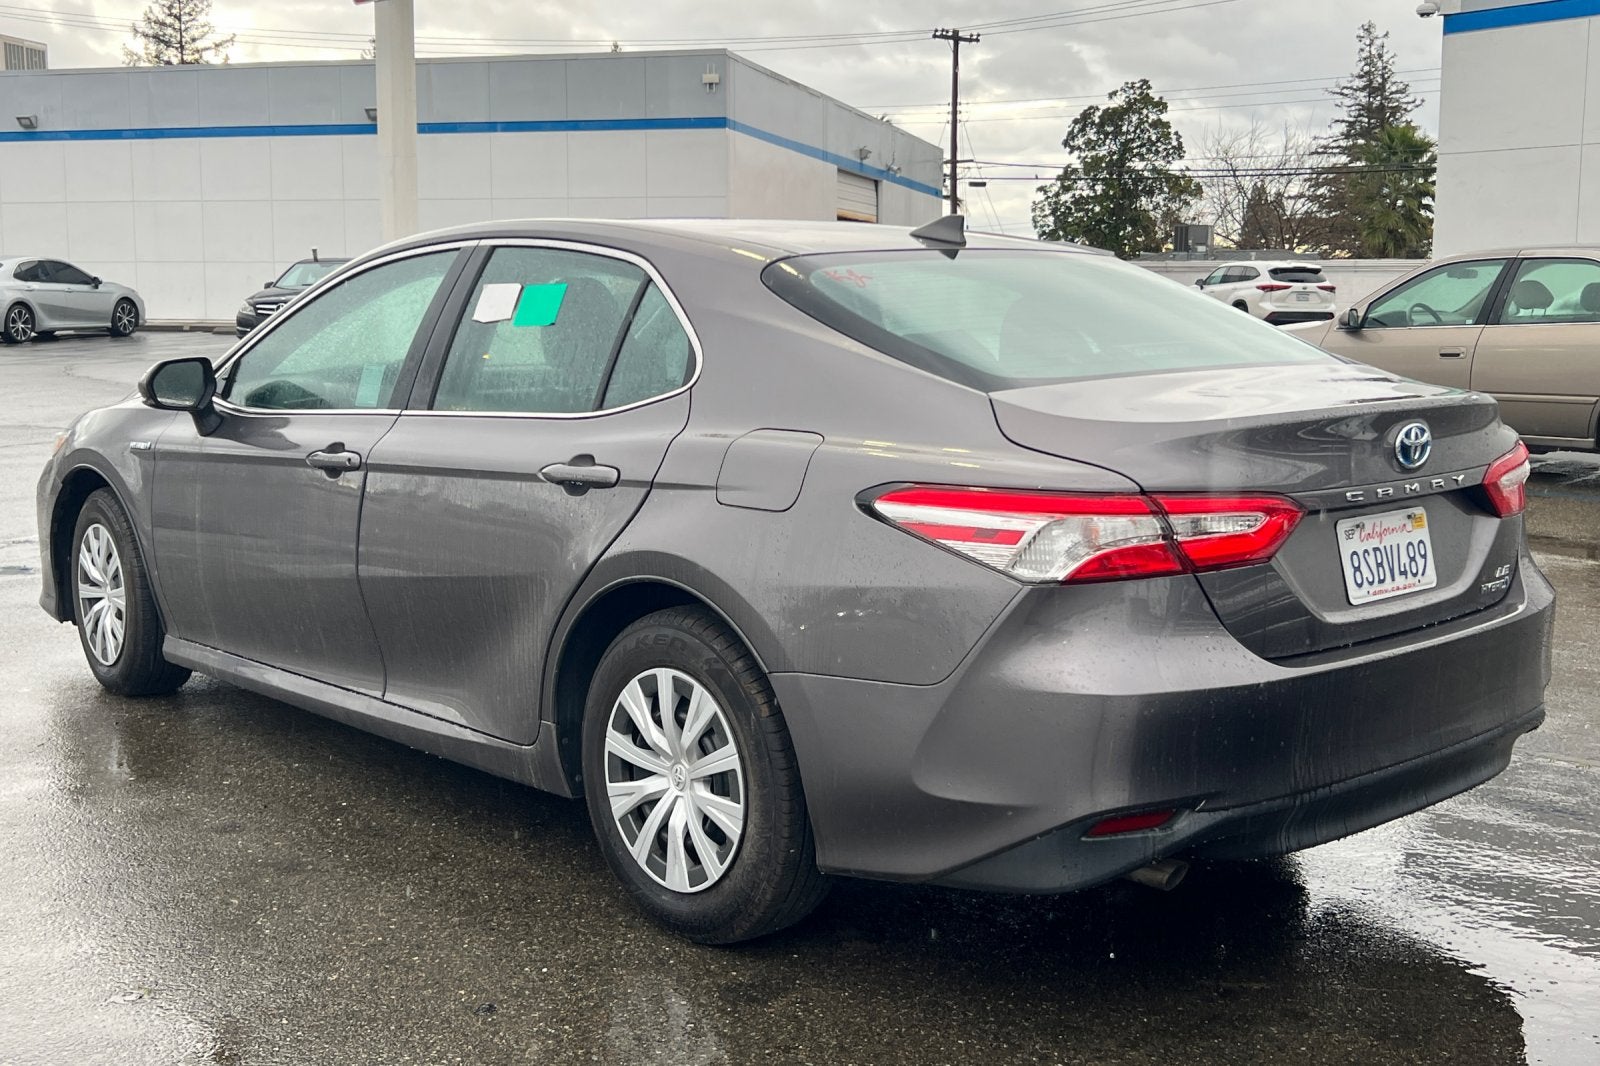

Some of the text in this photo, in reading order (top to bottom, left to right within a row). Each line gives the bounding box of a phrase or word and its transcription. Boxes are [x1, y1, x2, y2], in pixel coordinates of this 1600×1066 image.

[1345, 474, 1465, 501] CAMRY
[1343, 528, 1356, 541] SEP
[1359, 520, 1413, 544] California
[1350, 539, 1427, 588] 8SBV489
[1372, 582, 1416, 596] dmv.ca.gov
